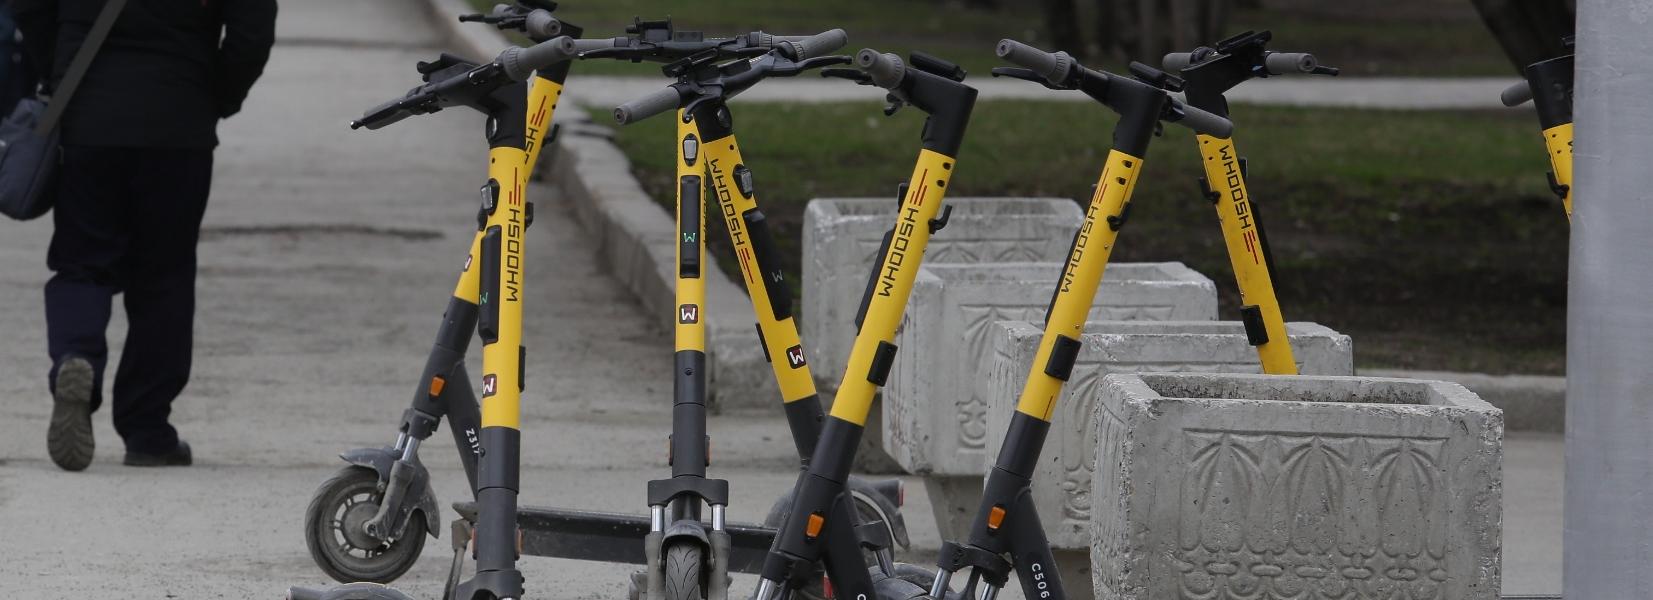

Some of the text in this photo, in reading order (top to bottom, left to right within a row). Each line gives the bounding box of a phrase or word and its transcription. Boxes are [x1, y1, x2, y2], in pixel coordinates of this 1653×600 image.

[710, 158, 745, 246] WHOOSH
[1219, 144, 1252, 229] WHOOSH
[506, 208, 520, 302] WHOOSH
[878, 207, 919, 297] WHOOSH
[1061, 205, 1099, 293] WHOOSH
[1031, 563, 1050, 599] C506
